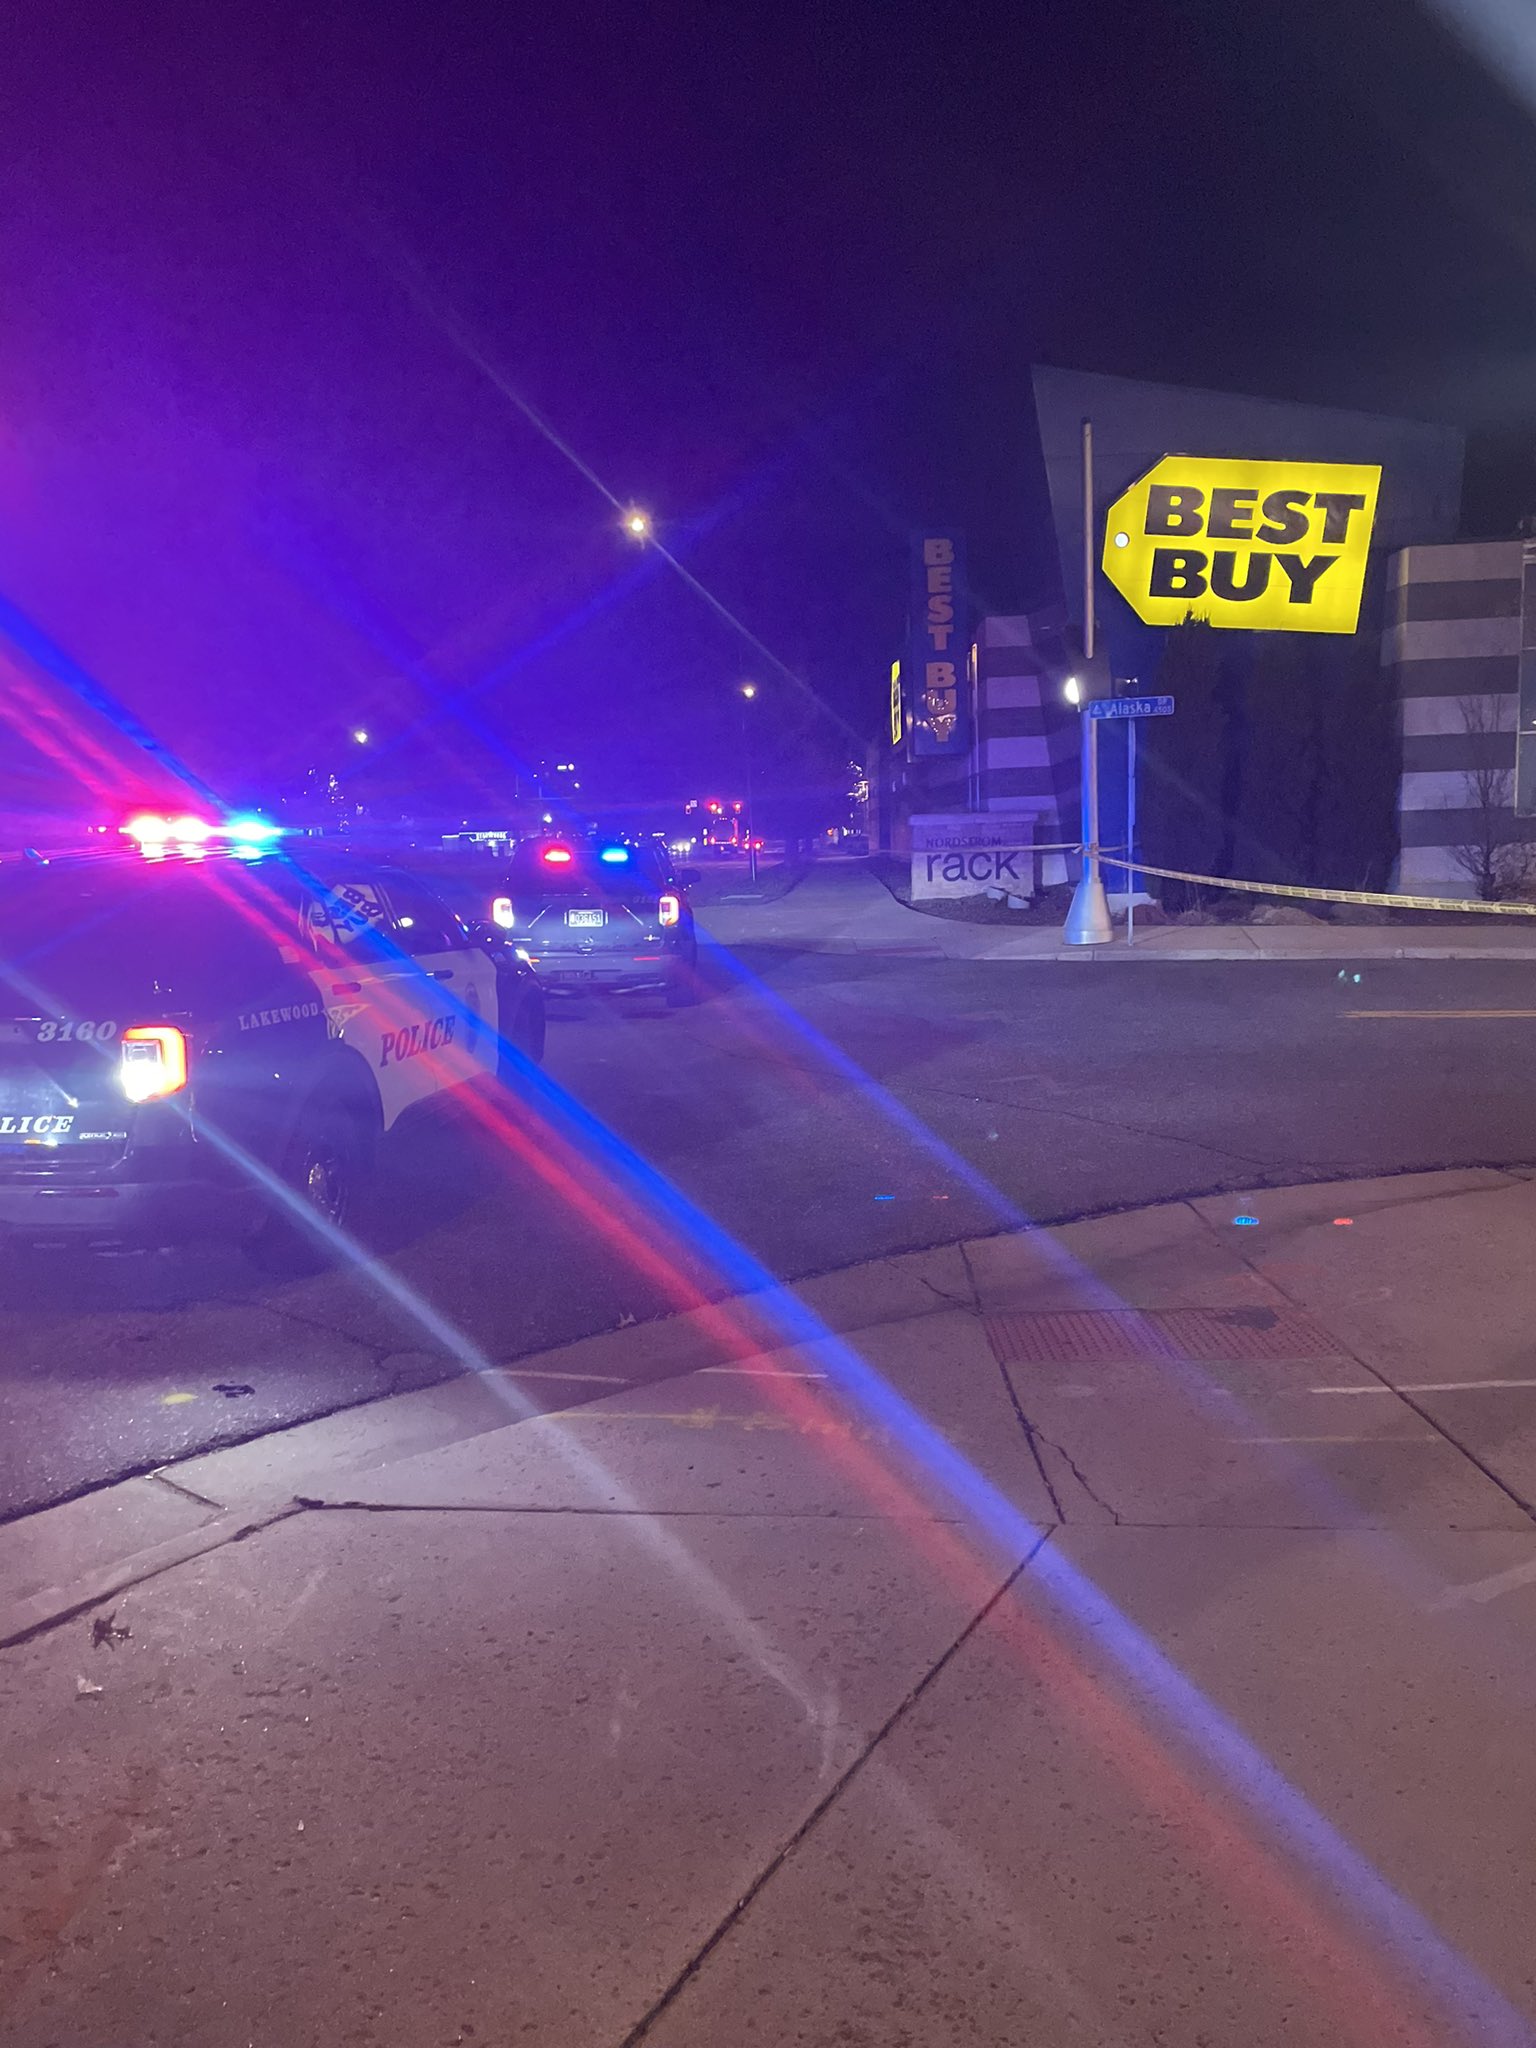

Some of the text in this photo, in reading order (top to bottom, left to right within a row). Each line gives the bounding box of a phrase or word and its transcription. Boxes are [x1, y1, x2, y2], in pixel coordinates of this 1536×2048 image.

[1144, 484, 1367, 545] BEST
[1149, 548, 1342, 604] BUY
[923, 538, 957, 742] BEST BUY
[1111, 701, 1151, 715] Alaska
[926, 836, 1002, 848] NORDSTROM
[926, 850, 1020, 882] rack
[37, 1021, 117, 1042] 3160
[238, 1002, 319, 1031] LAKEWOOD
[379, 1015, 456, 1068] POLICE
[0, 1115, 74, 1134] LICE
